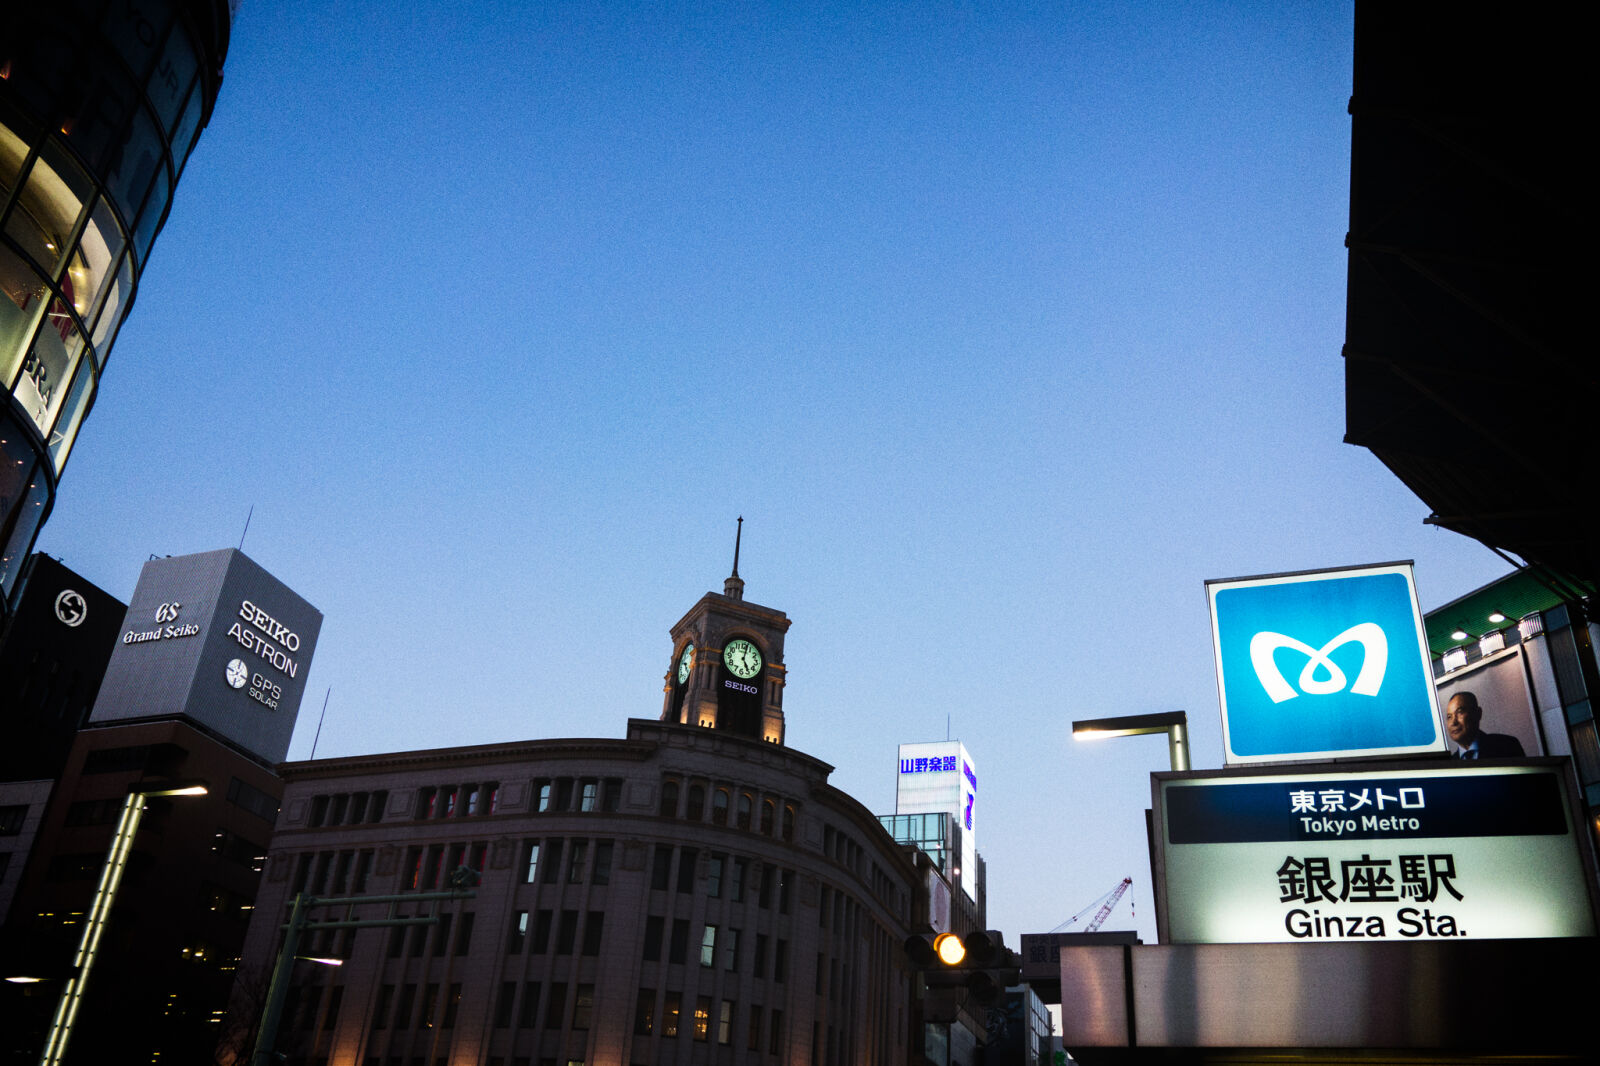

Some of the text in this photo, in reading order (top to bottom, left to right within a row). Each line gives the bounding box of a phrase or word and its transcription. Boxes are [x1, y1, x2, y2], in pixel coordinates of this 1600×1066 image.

[155, 602, 180, 623] GS
[123, 623, 200, 644] Grand Seiko
[239, 600, 300, 652] SEIKO
[227, 622, 298, 678] ASTRON
[248, 687, 278, 710] SOLAR
[252, 672, 282, 700] GPS
[725, 680, 757, 694] SEIKO
[900, 755, 957, 774] 山野楽器
[1289, 787, 1425, 814] 東京メトロ
[1300, 815, 1420, 837] Tokyo Metro
[1275, 853, 1465, 904] 銀座駅
[1284, 908, 1467, 938] Ginza Sta.
